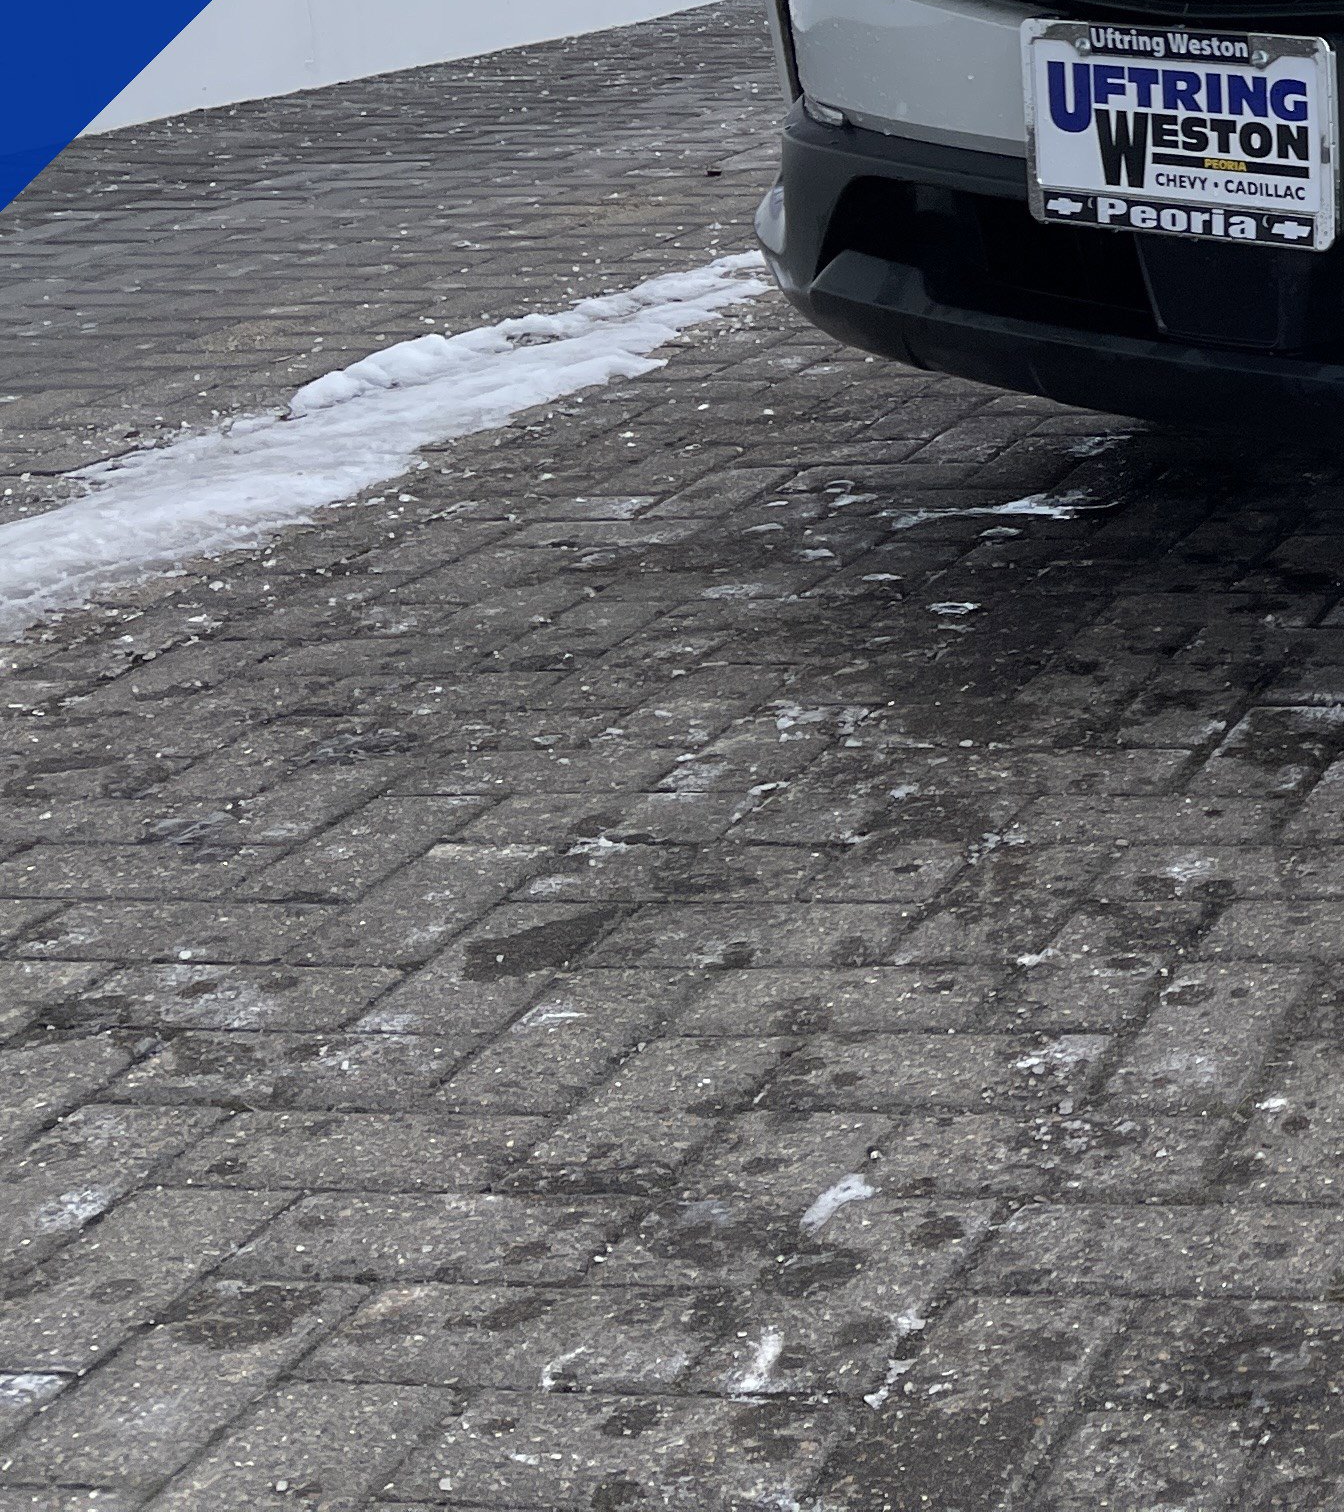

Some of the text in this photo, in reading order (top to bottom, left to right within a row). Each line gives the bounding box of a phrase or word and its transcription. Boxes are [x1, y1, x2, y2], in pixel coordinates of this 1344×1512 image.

[1089, 27, 1249, 59] Uftring Weston
[1047, 60, 1308, 133] UFTRING
[1094, 108, 1310, 188] WESTON
[1204, 157, 1247, 172] PEORIA
[1155, 172, 1306, 201] CHEVY CADILLAC
[1096, 196, 1257, 240] Peoria
